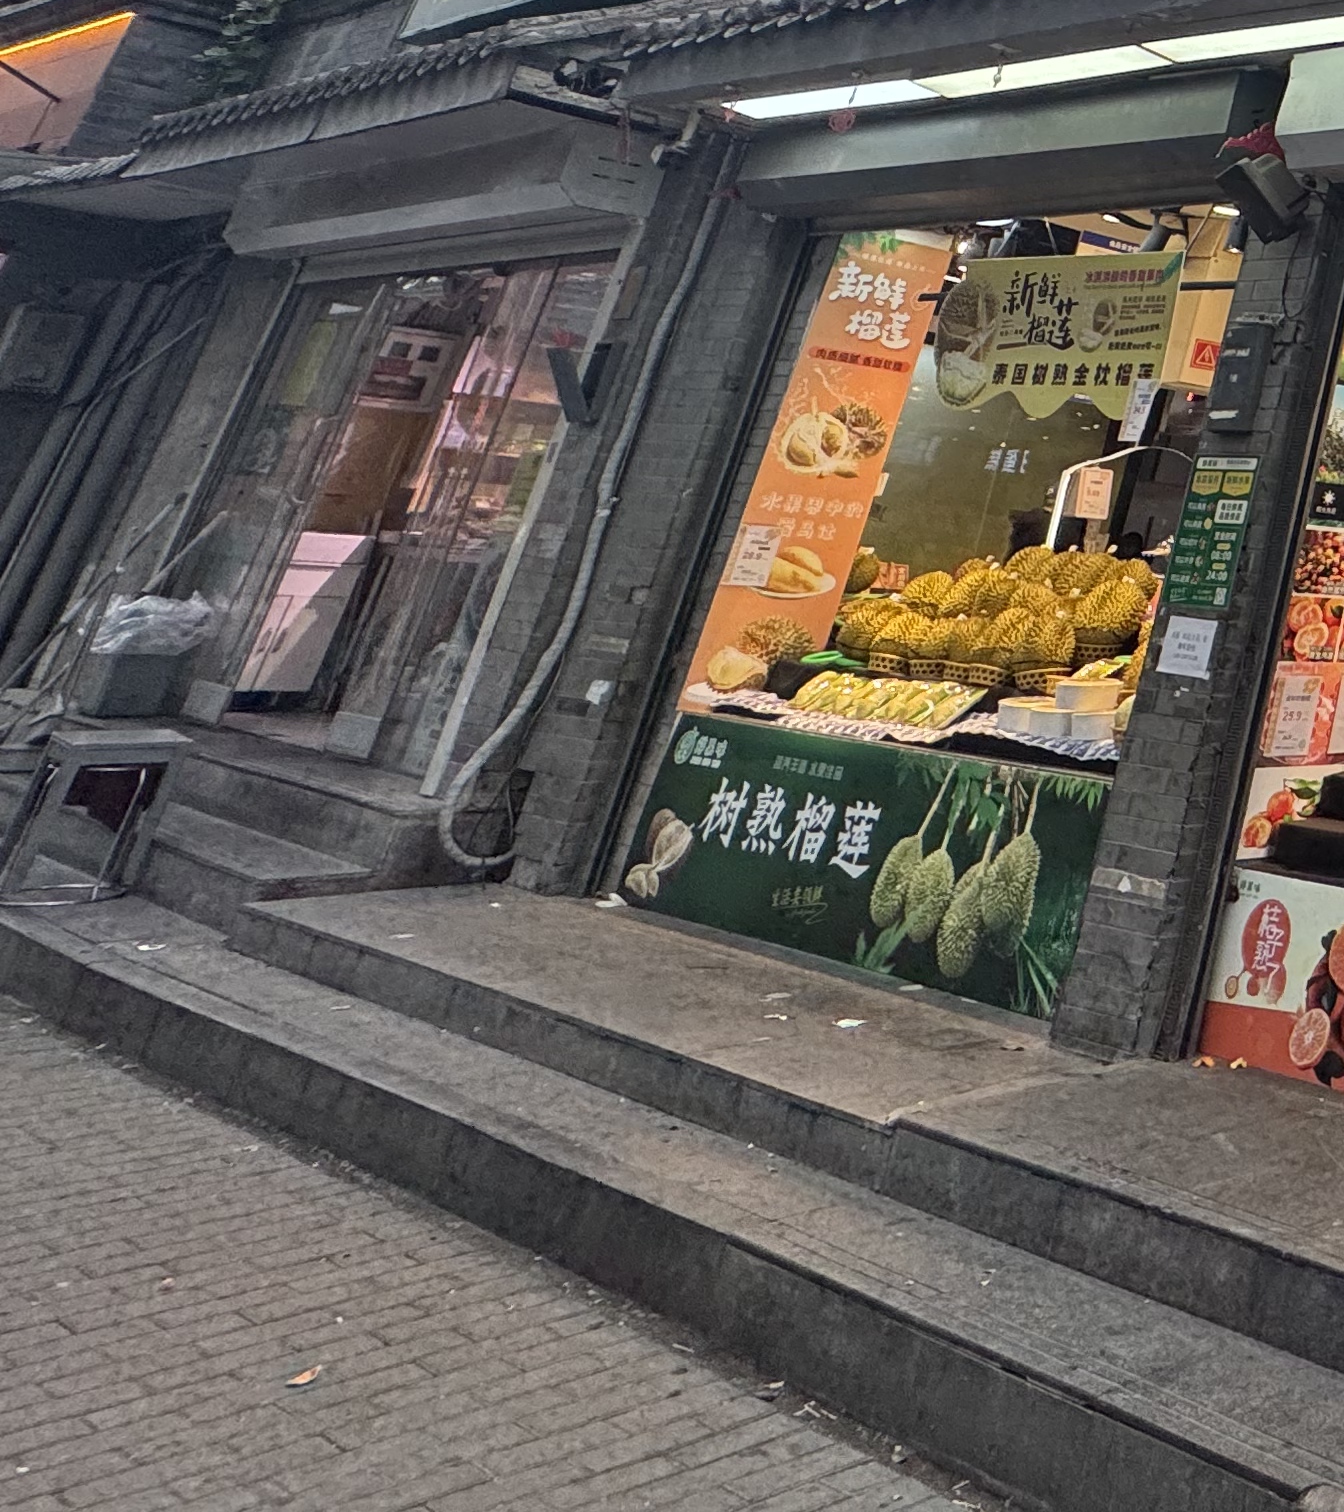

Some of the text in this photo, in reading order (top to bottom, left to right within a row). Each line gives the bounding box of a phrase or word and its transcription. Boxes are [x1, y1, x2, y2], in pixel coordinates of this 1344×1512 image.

[828, 260, 908, 310] 新鲜
[1002, 270, 1062, 318] 新鲜
[845, 309, 911, 350] 榴莲
[698, 776, 882, 879] 树熟榴莲
